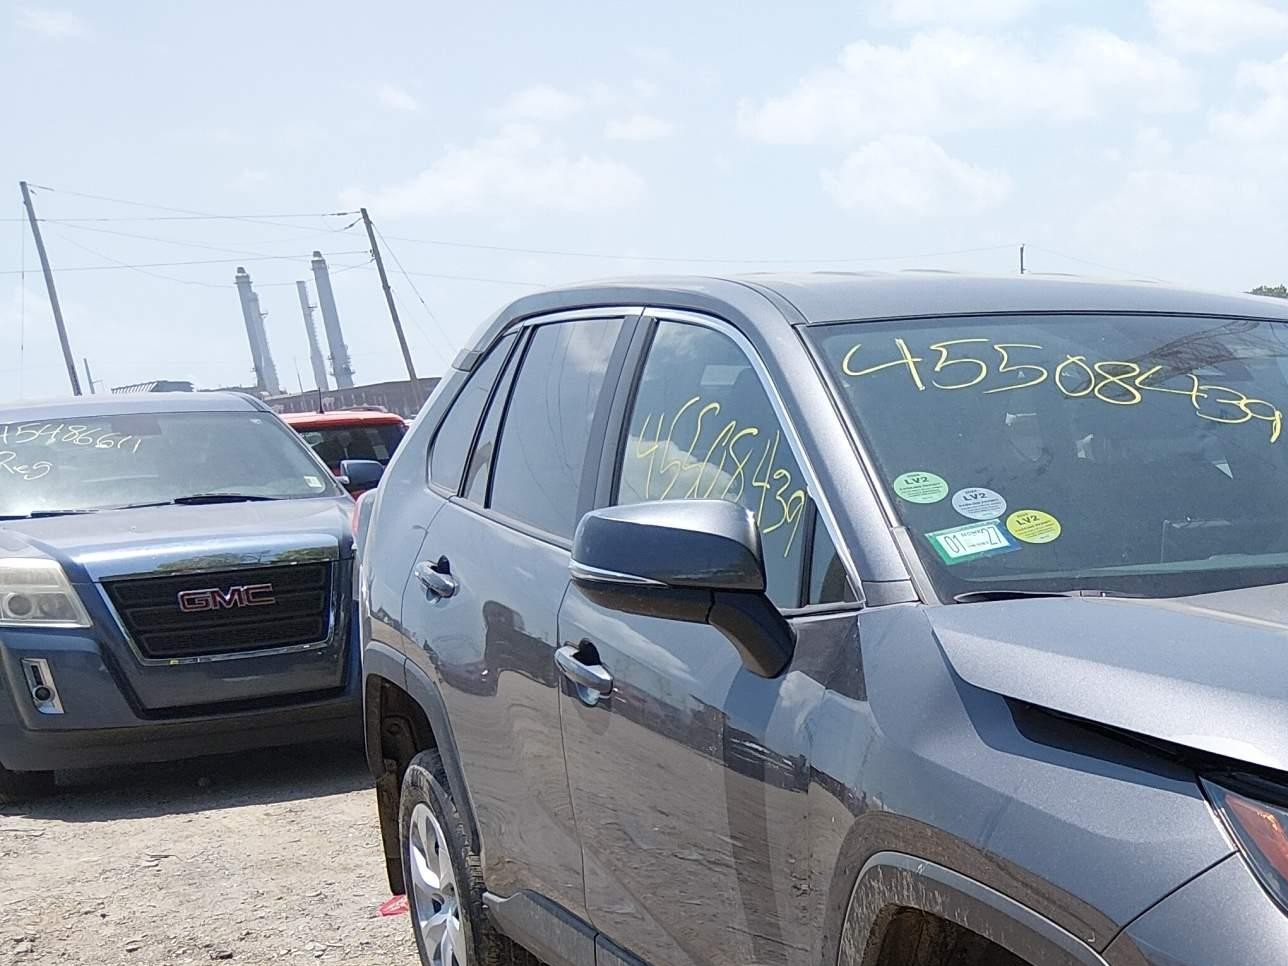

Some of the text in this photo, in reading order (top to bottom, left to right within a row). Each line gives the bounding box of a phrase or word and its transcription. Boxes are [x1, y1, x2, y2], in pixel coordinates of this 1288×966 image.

[843, 337, 1282, 443] 45508439
[904, 476, 929, 485] LV2
[963, 492, 988, 501] LV2
[1015, 515, 1040, 526] LV2
[943, 534, 967, 554] 01
[981, 526, 1002, 546] 27
[178, 583, 276, 612] GMC
